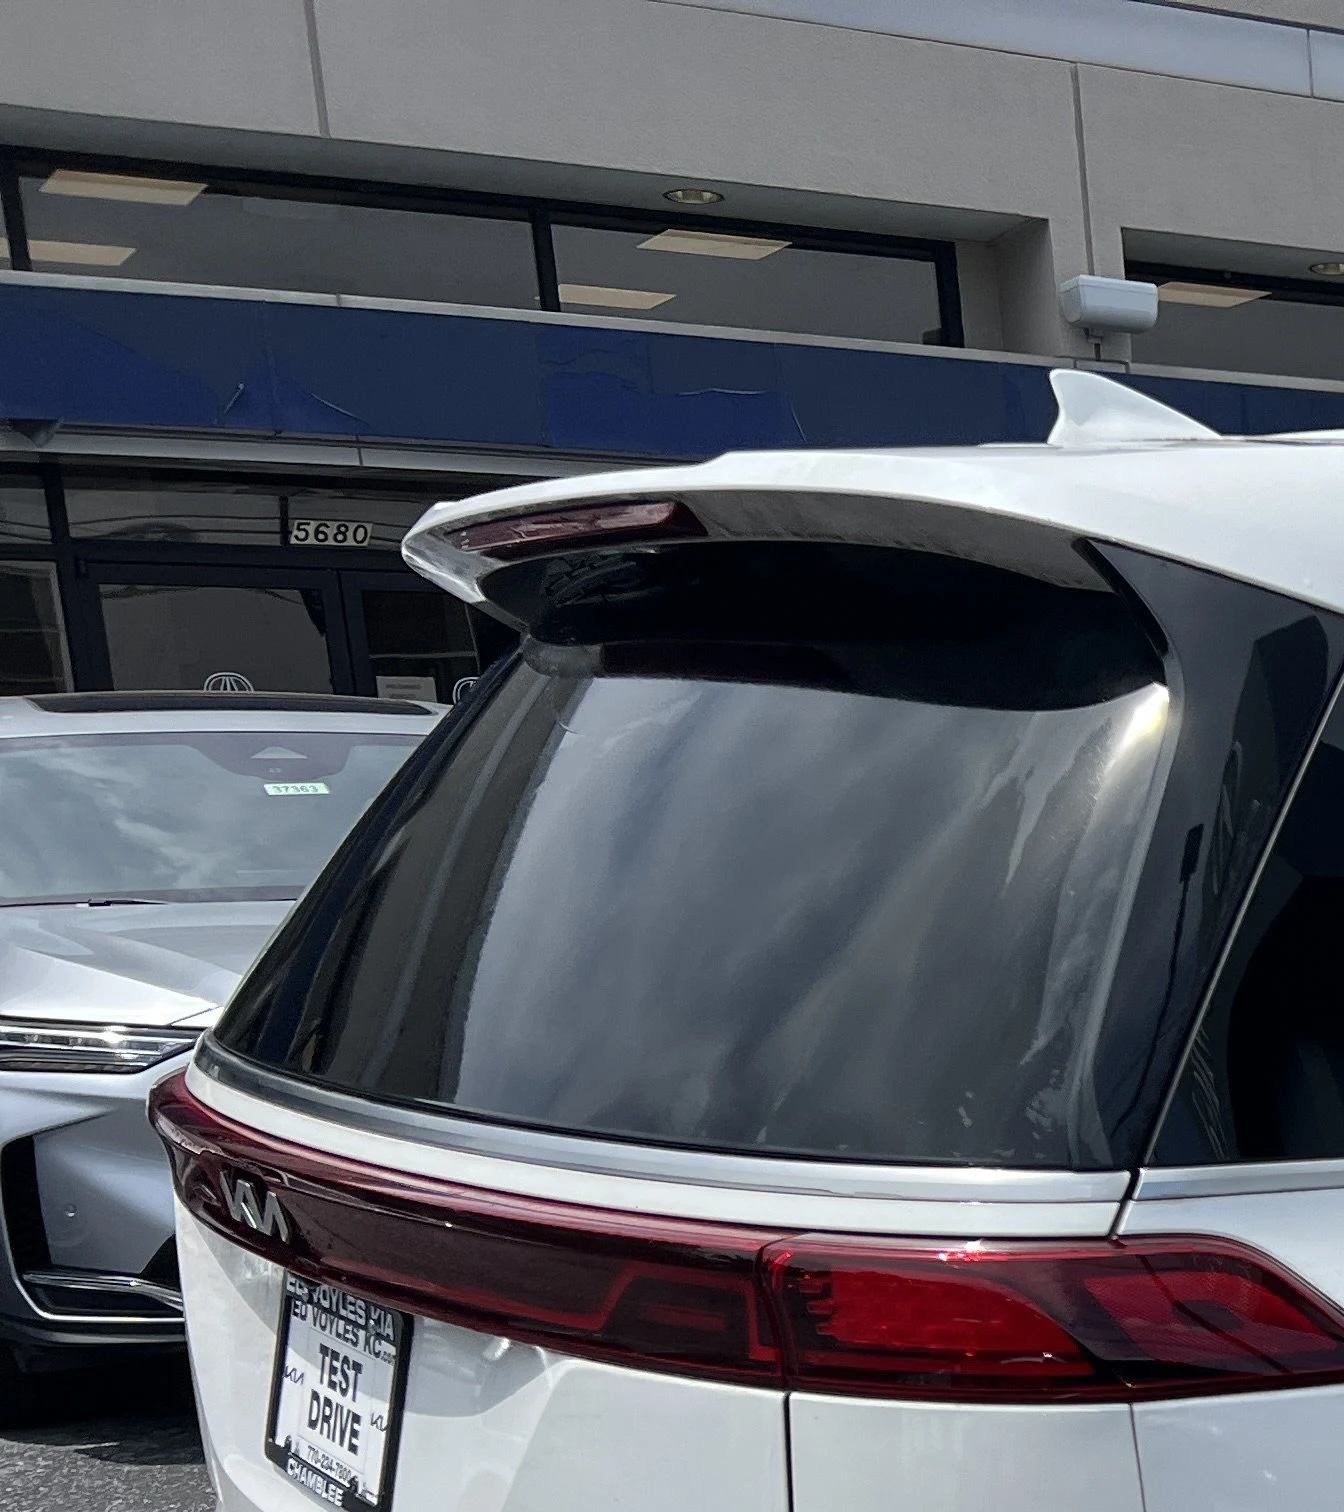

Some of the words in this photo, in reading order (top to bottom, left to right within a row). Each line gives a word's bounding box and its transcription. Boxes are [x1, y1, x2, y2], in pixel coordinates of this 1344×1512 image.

[294, 522, 367, 544] 5680
[292, 1300, 308, 1321] ED
[312, 1306, 360, 1348] VOYLES
[313, 1284, 366, 1326] VOYLES
[318, 1343, 363, 1402] TEST
[307, 1389, 362, 1456] DRIVE
[287, 1458, 344, 1507] CHAMBLEE
